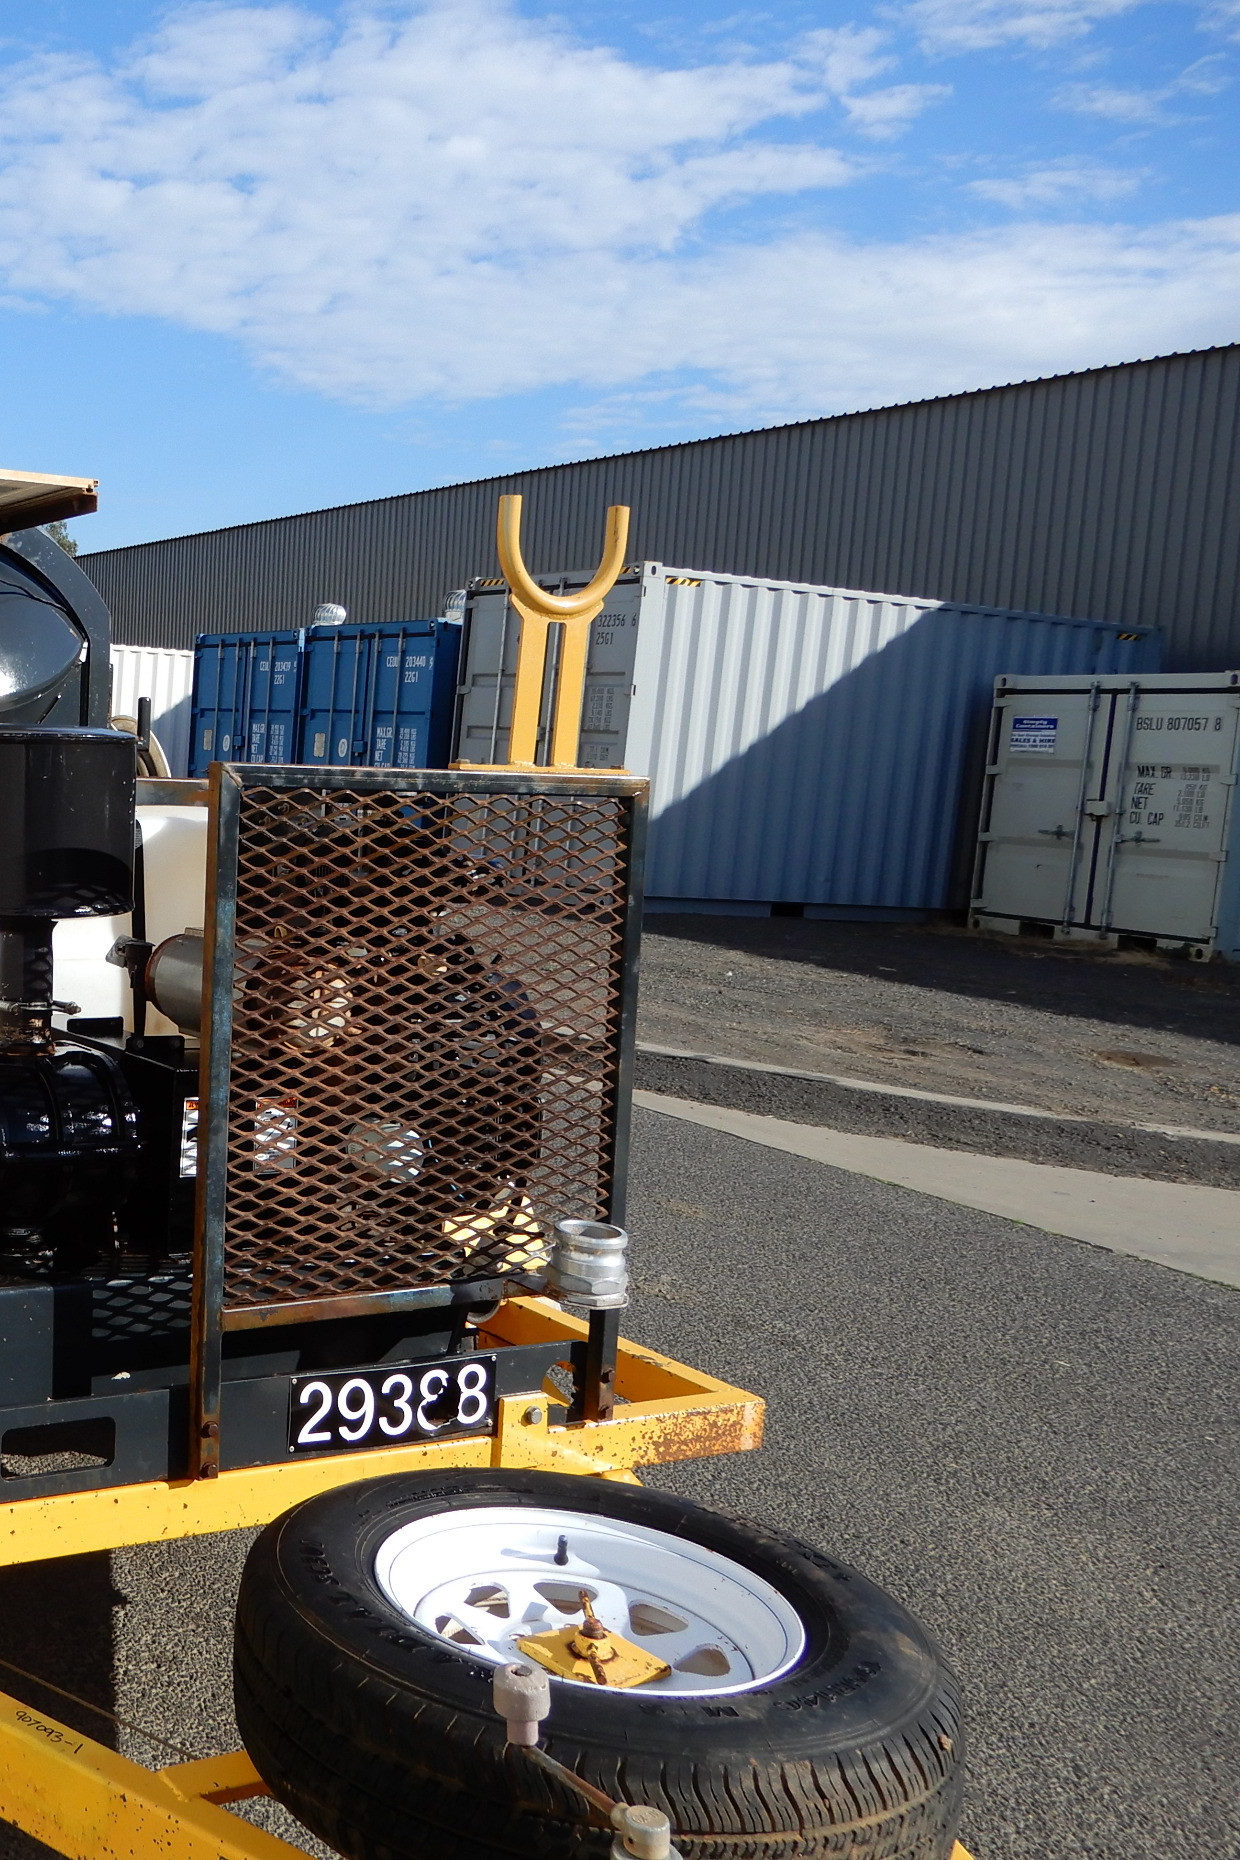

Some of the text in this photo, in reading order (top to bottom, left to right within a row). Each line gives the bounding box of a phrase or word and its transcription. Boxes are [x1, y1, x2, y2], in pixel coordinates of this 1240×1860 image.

[597, 614, 626, 627] 322356
[595, 632, 614, 645] 25G1
[1136, 717, 1223, 731] BSLU 807057 8
[1134, 782, 1156, 795] TARE
[1130, 796, 1149, 810] NET
[1147, 812, 1164, 826] CAP
